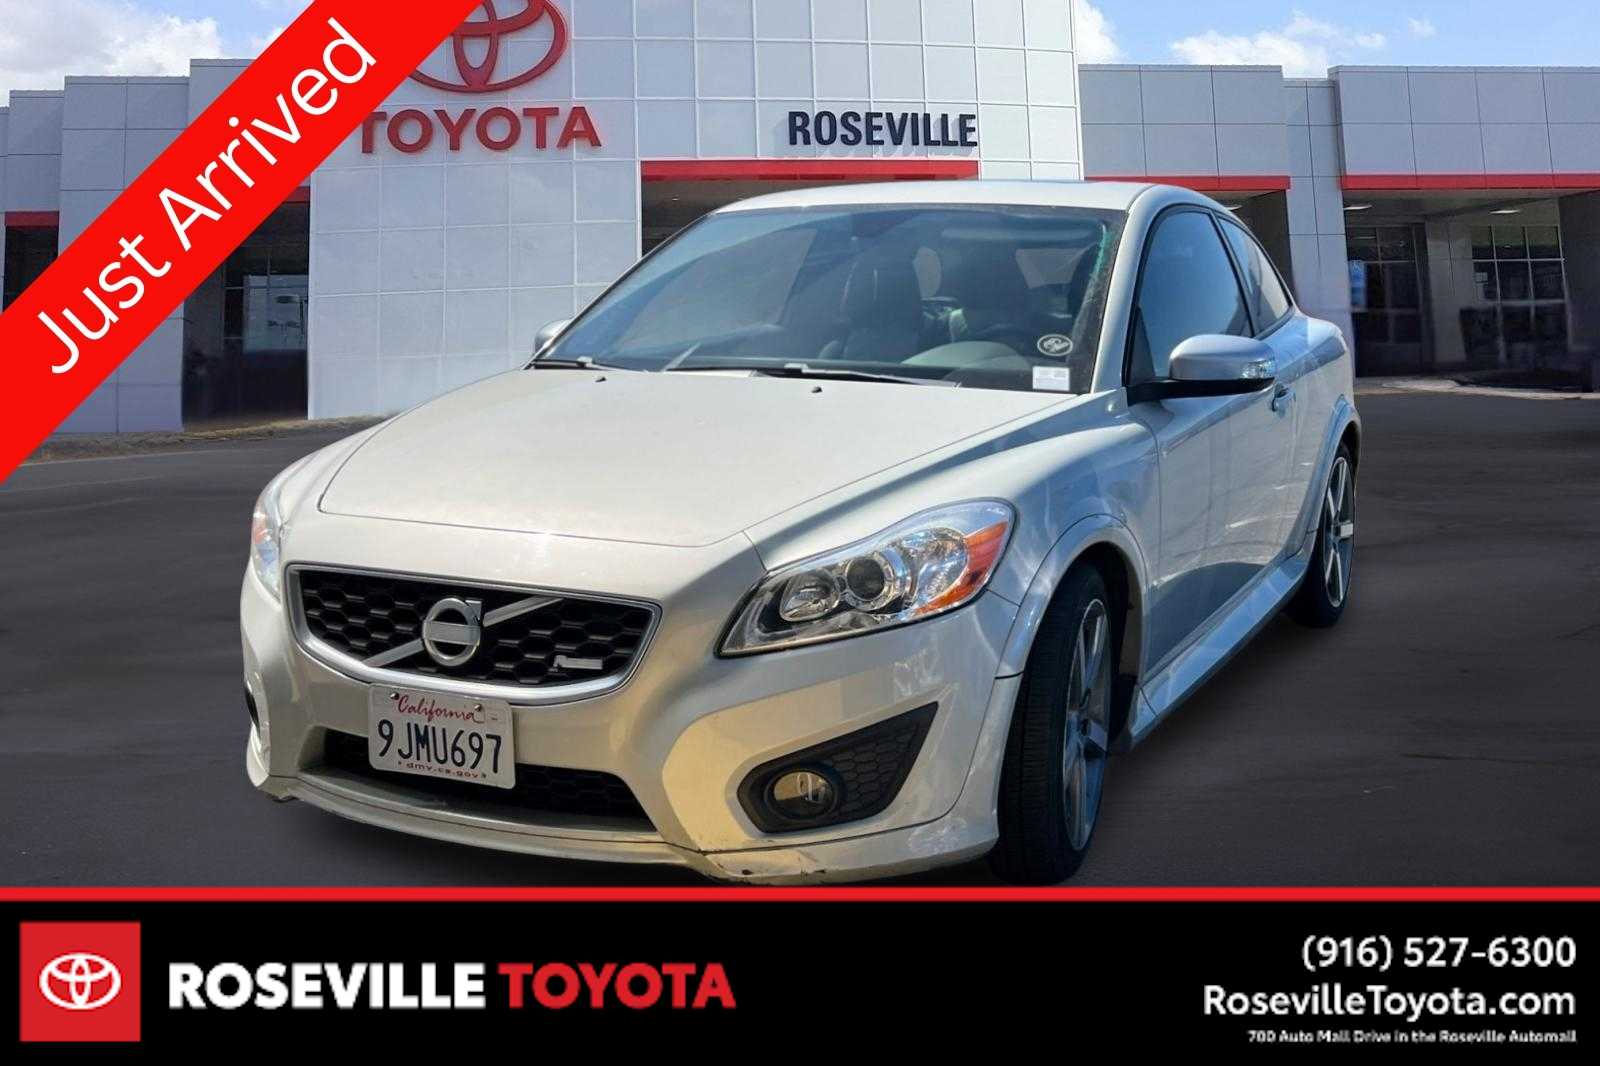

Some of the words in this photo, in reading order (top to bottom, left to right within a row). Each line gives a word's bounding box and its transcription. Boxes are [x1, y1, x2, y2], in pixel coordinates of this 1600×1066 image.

[361, 106, 602, 153] TOYOTA
[788, 110, 978, 147] ROSEVILLE
[397, 693, 484, 723] California
[377, 718, 502, 775] 9JMU697
